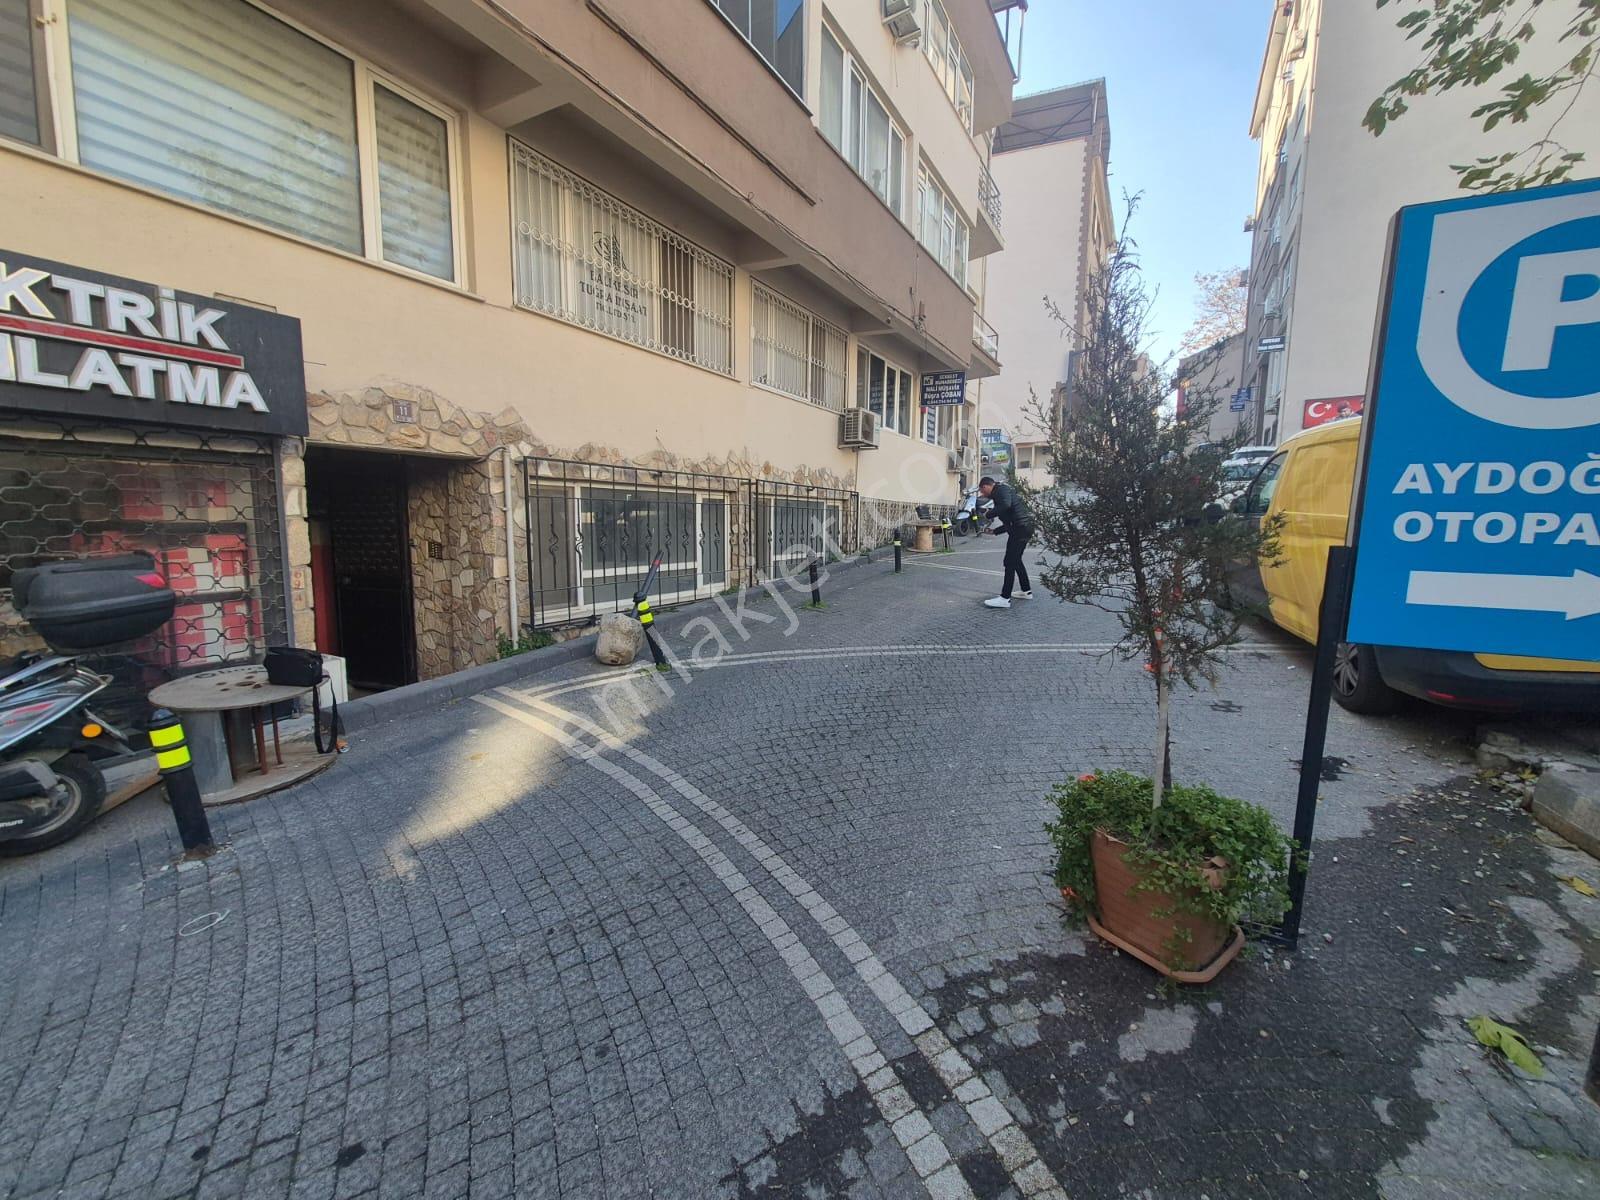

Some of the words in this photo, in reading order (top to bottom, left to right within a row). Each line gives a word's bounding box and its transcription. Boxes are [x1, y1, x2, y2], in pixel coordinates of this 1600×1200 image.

[1500, 247, 1600, 372] P
[940, 390, 962, 399] ÇOBAN
[399, 406, 408, 416] 11
[1392, 510, 1600, 546] OTOPA
